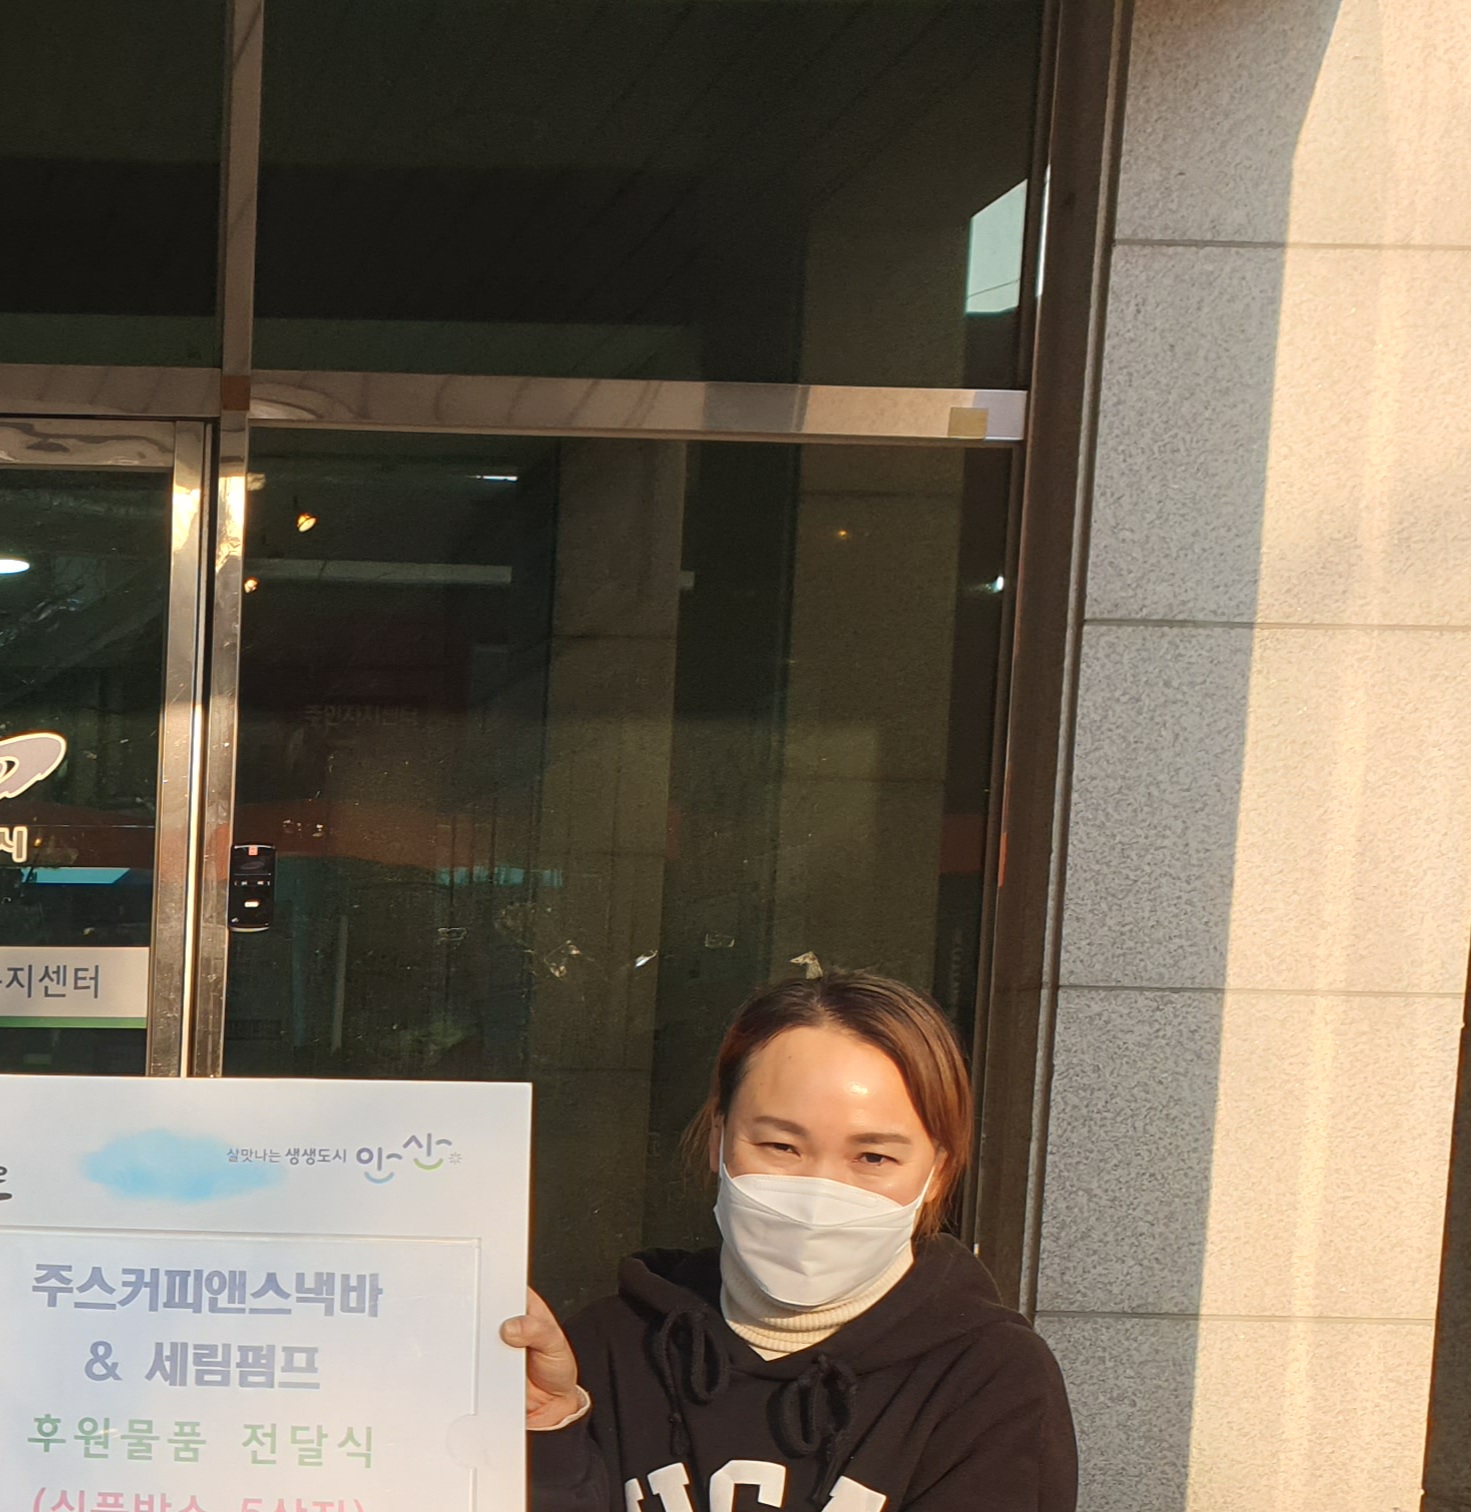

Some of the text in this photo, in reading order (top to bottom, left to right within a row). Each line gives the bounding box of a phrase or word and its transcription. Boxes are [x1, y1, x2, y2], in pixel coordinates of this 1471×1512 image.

[226, 1148, 281, 1163] 살맛나는
[284, 1147, 347, 1166] 생생도시
[31, 1263, 383, 1318] 주스커피앤스낵바
[83, 1340, 321, 1389] & 세림펌프
[26, 1412, 374, 1469] 후원물품 전달식
